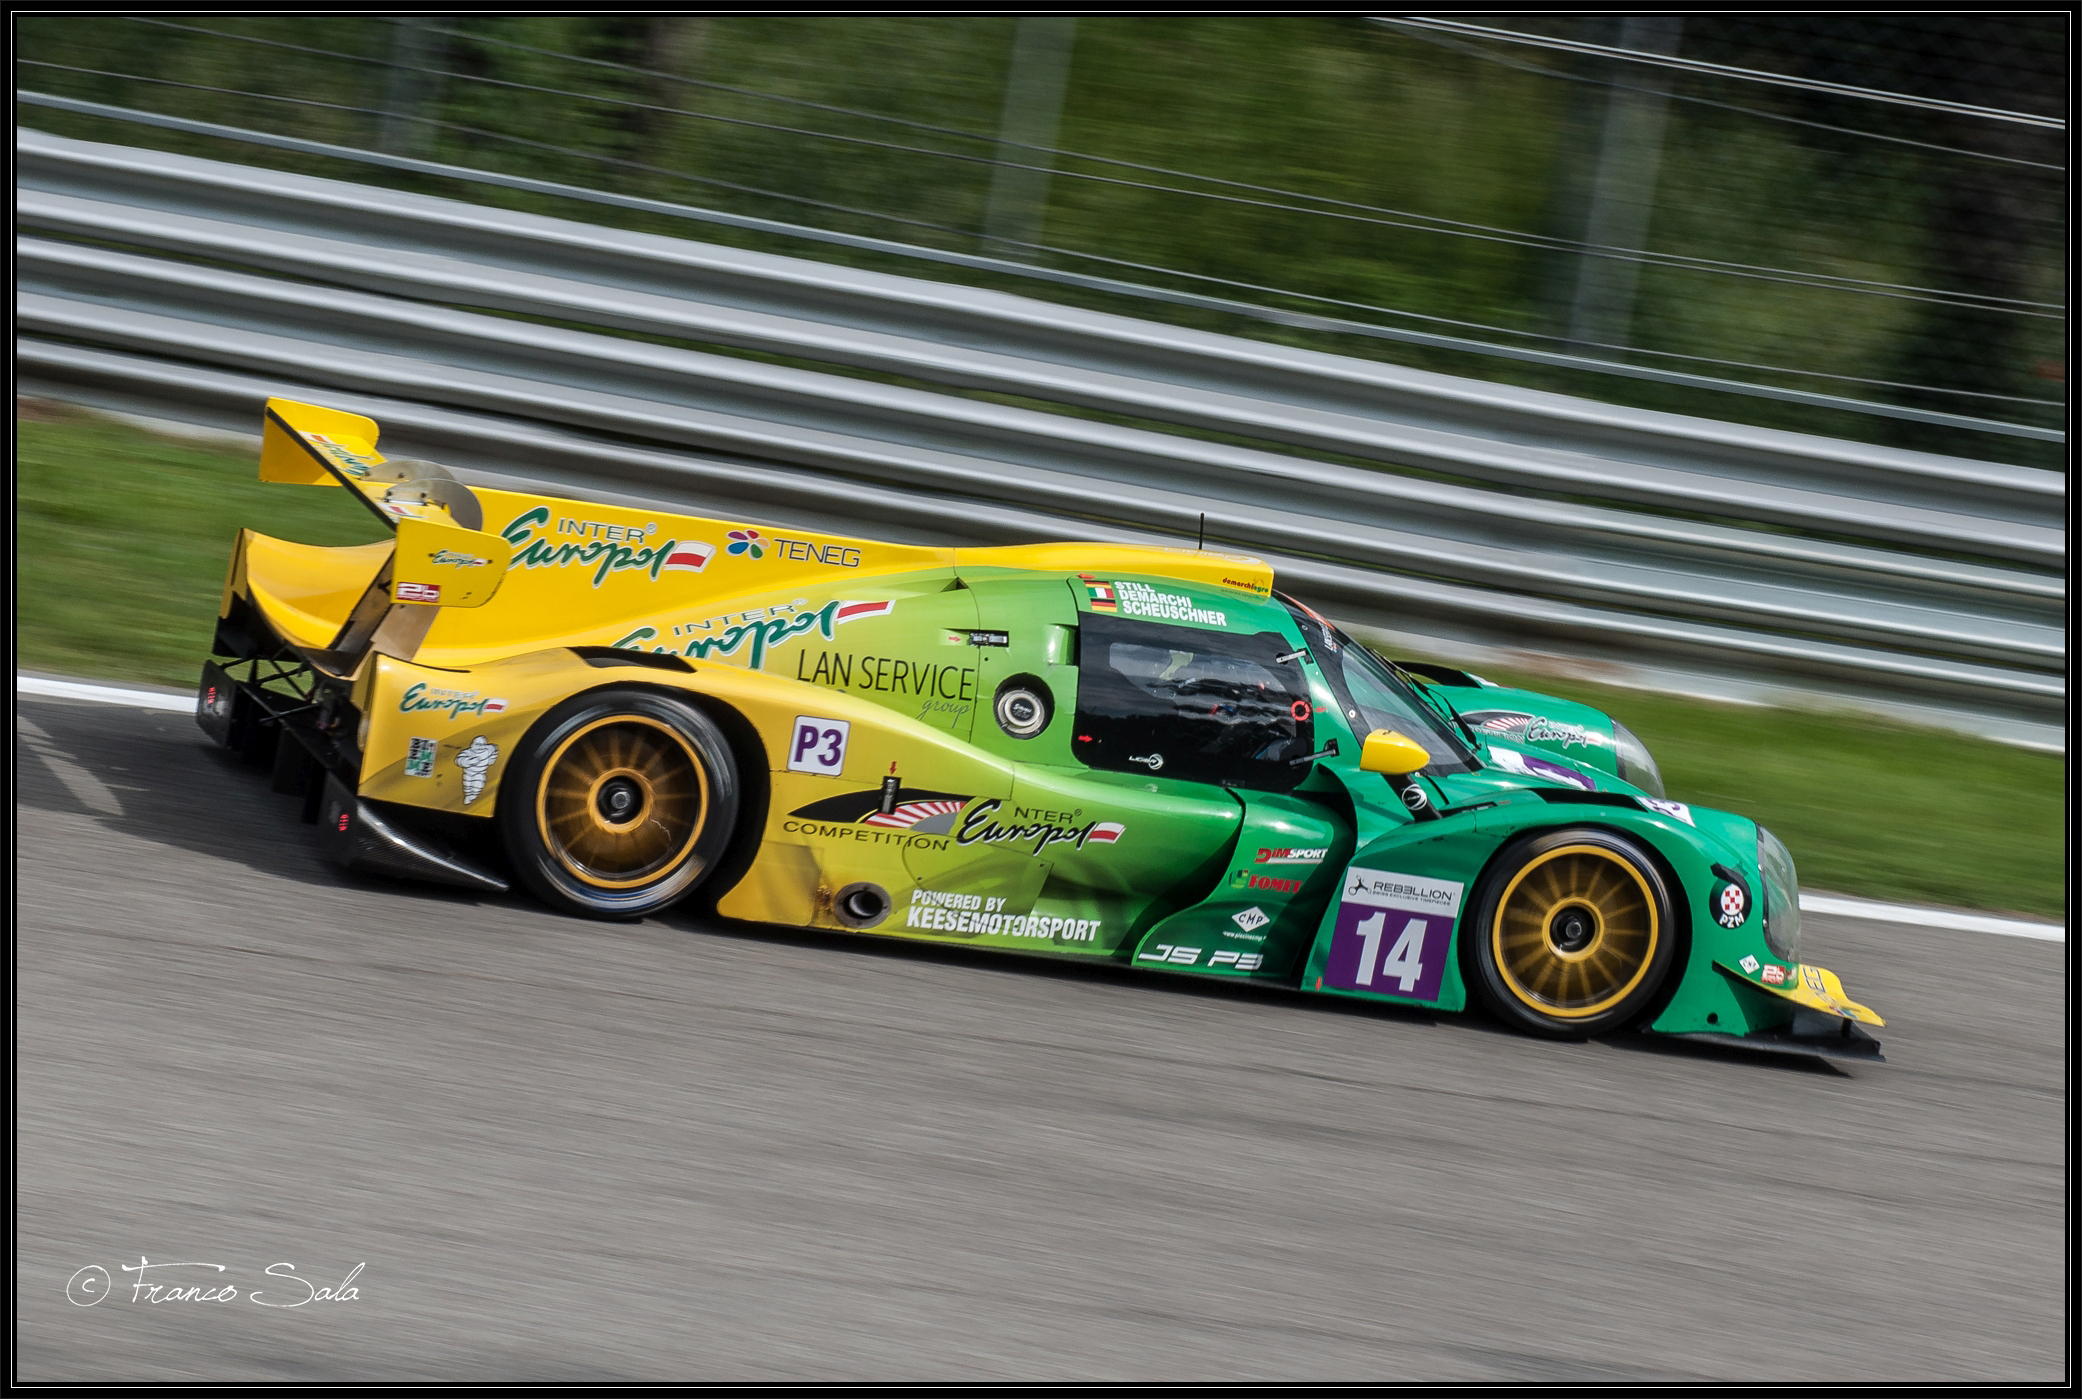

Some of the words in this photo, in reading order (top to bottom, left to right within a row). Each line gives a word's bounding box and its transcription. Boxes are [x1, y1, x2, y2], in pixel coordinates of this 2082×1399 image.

[774, 538, 861, 568] TENEG
[1114, 581, 1155, 593] STILL
[1119, 590, 1192, 608] DEMARCHI
[1122, 601, 1227, 626] SCHEUSCHNER
[797, 649, 853, 687] LAN
[858, 656, 975, 702] SERVICE
[915, 700, 971, 729] group
[793, 724, 843, 767] P3
[782, 820, 950, 851] COMPETITION
[956, 799, 1097, 857] Europol
[1248, 874, 1302, 895] FOMET
[1373, 881, 1453, 902] REBELLION
[910, 889, 983, 911] POWERED
[985, 897, 1007, 912] BY
[906, 906, 1101, 942] KEESEMOTORSPORT
[1238, 914, 1265, 926] CMP
[1719, 912, 1745, 928] PZM
[1138, 944, 1202, 965] JS
[1207, 950, 1264, 970] P3
[1355, 911, 1428, 993] 14
